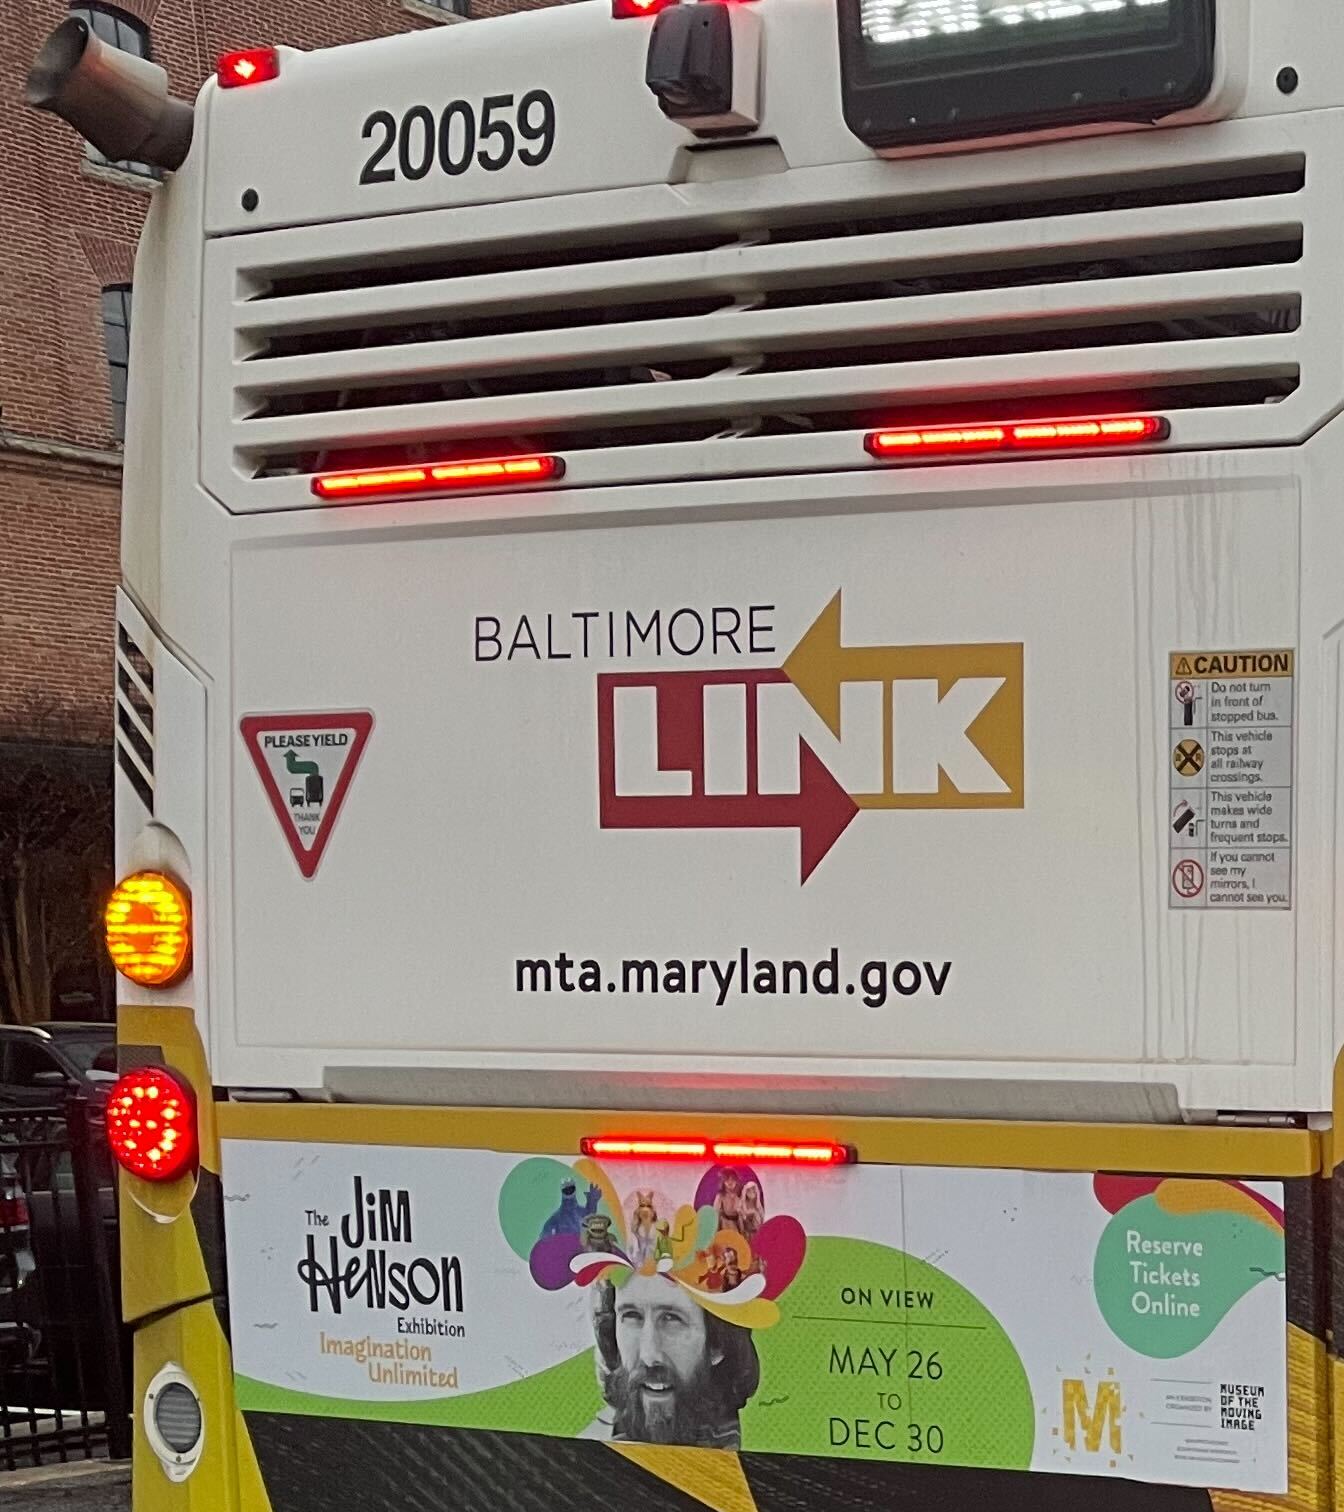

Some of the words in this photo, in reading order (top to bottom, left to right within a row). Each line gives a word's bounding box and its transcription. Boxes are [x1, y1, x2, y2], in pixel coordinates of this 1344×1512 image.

[359, 88, 556, 185] 20059
[474, 605, 776, 662] BALTIMORE
[1193, 653, 1289, 674] CAUTION
[1211, 681, 1226, 693] Do
[1229, 682, 1247, 693] not
[1249, 682, 1271, 692] turn
[1211, 697, 1221, 707] in
[1224, 695, 1250, 707] front
[1252, 695, 1264, 706] of
[1211, 710, 1254, 724] stopped
[1256, 711, 1279, 721] bus.
[264, 734, 311, 748] PLEASE
[311, 733, 348, 747] YIELD
[612, 676, 1013, 797] LINK
[1211, 731, 1233, 741] This
[1235, 730, 1273, 741] vehicle
[1211, 746, 1239, 757] stops
[1242, 746, 1252, 755] at
[1211, 758, 1223, 769] all
[1226, 758, 1264, 769] railway
[1210, 773, 1263, 784] crossings.
[1211, 791, 1233, 802] This
[1235, 790, 1273, 802] vehicle
[294, 812, 321, 822] THANK
[1210, 804, 1244, 816] makes
[1247, 804, 1273, 815] wide
[299, 825, 316, 835] YOU
[1210, 818, 1237, 829] turns
[1239, 818, 1260, 828] and
[1210, 832, 1254, 845] frequent
[1256, 832, 1288, 844] stops.
[1210, 851, 1217, 861] If
[1219, 852, 1238, 864] you
[1240, 852, 1275, 862] cannot
[1210, 867, 1228, 875] see
[1230, 867, 1247, 876] my
[1210, 878, 1250, 889] mirrors,
[1210, 892, 1244, 903] cannot
[1246, 893, 1265, 902] see
[1266, 893, 1288, 904] you.
[515, 947, 953, 1008] mta.maryland.gov
[304, 1209, 329, 1227] The
[1126, 1229, 1204, 1257] Reserve
[1129, 1260, 1201, 1287] Tickets
[840, 1287, 872, 1306] ON
[880, 1288, 934, 1309] VIEW
[1131, 1290, 1201, 1317] Online
[396, 1316, 466, 1338] Exhibition
[319, 1331, 432, 1364] Imagination
[828, 1343, 898, 1377] MAY
[906, 1349, 943, 1380] 26
[367, 1361, 459, 1389] Unlimited
[1220, 1383, 1265, 1397] MUSEUM
[877, 1392, 902, 1411] TO
[1220, 1395, 1235, 1406] OF
[1238, 1396, 1259, 1408] THE
[1061, 1378, 1122, 1455] M
[1220, 1407, 1262, 1420] MOVING
[1220, 1418, 1256, 1431] IMAGE
[829, 1416, 896, 1450] DEC
[907, 1423, 944, 1454] 30
